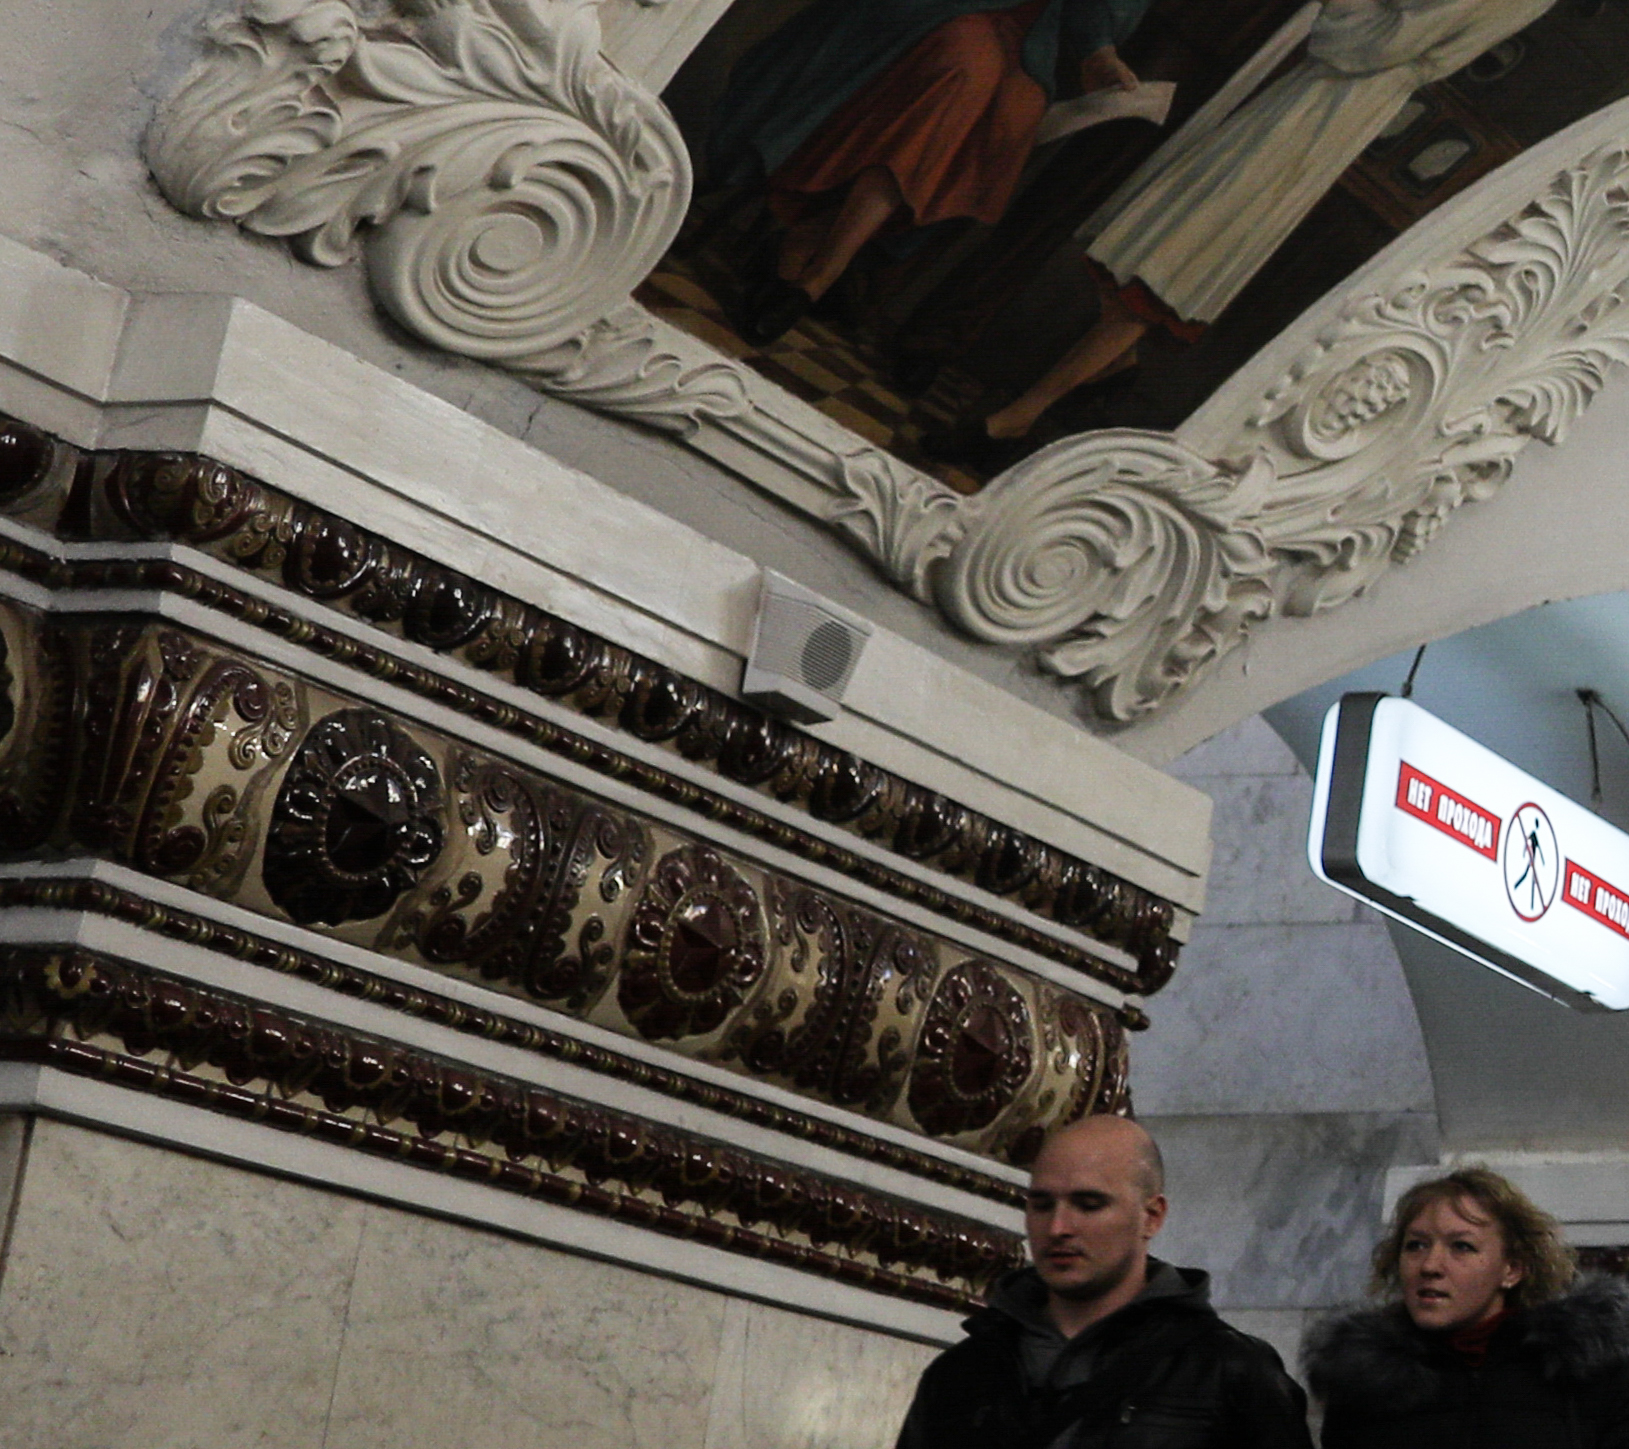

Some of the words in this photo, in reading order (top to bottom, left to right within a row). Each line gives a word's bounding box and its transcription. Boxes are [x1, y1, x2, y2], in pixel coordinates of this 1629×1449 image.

[1407, 777, 1433, 813] НЕТ
[1437, 794, 1494, 849] ПРОХОДА
[1570, 871, 1592, 905] НЕТ
